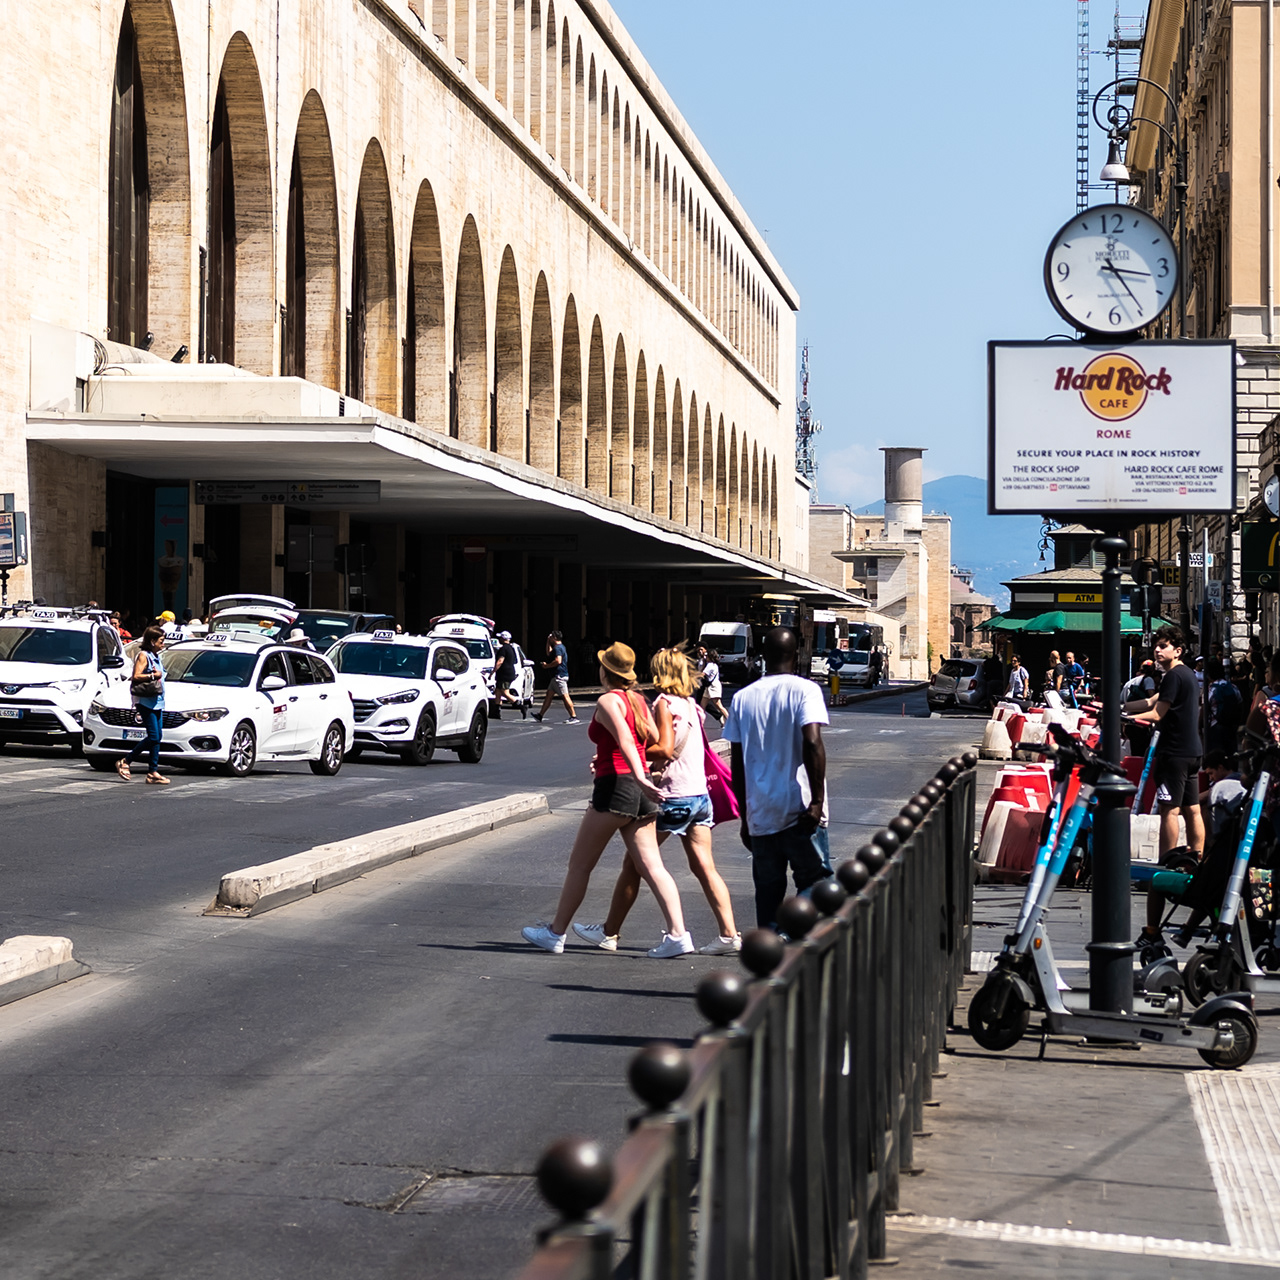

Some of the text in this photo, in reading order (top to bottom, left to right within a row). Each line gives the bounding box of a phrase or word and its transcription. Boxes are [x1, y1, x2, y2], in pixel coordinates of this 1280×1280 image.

[1099, 213, 1124, 234] 12
[1057, 258, 1169, 282] 9 3
[1109, 306, 1121, 325] 6
[1055, 366, 1172, 395] Hard Rock
[1099, 399, 1128, 409] CAFE
[1096, 430, 1132, 439] ROME
[1017, 450, 1201, 458] SECURE YOUR PLACE IN ROCK HISTORY
[1012, 465, 1080, 473] THE ROCK SHOP
[1124, 465, 1224, 473] HARD ROCK CAFE ROME
[1075, 594, 1095, 602] ATM
[1054, 818, 1074, 859] BIRD
[1244, 817, 1258, 854] BIRD
